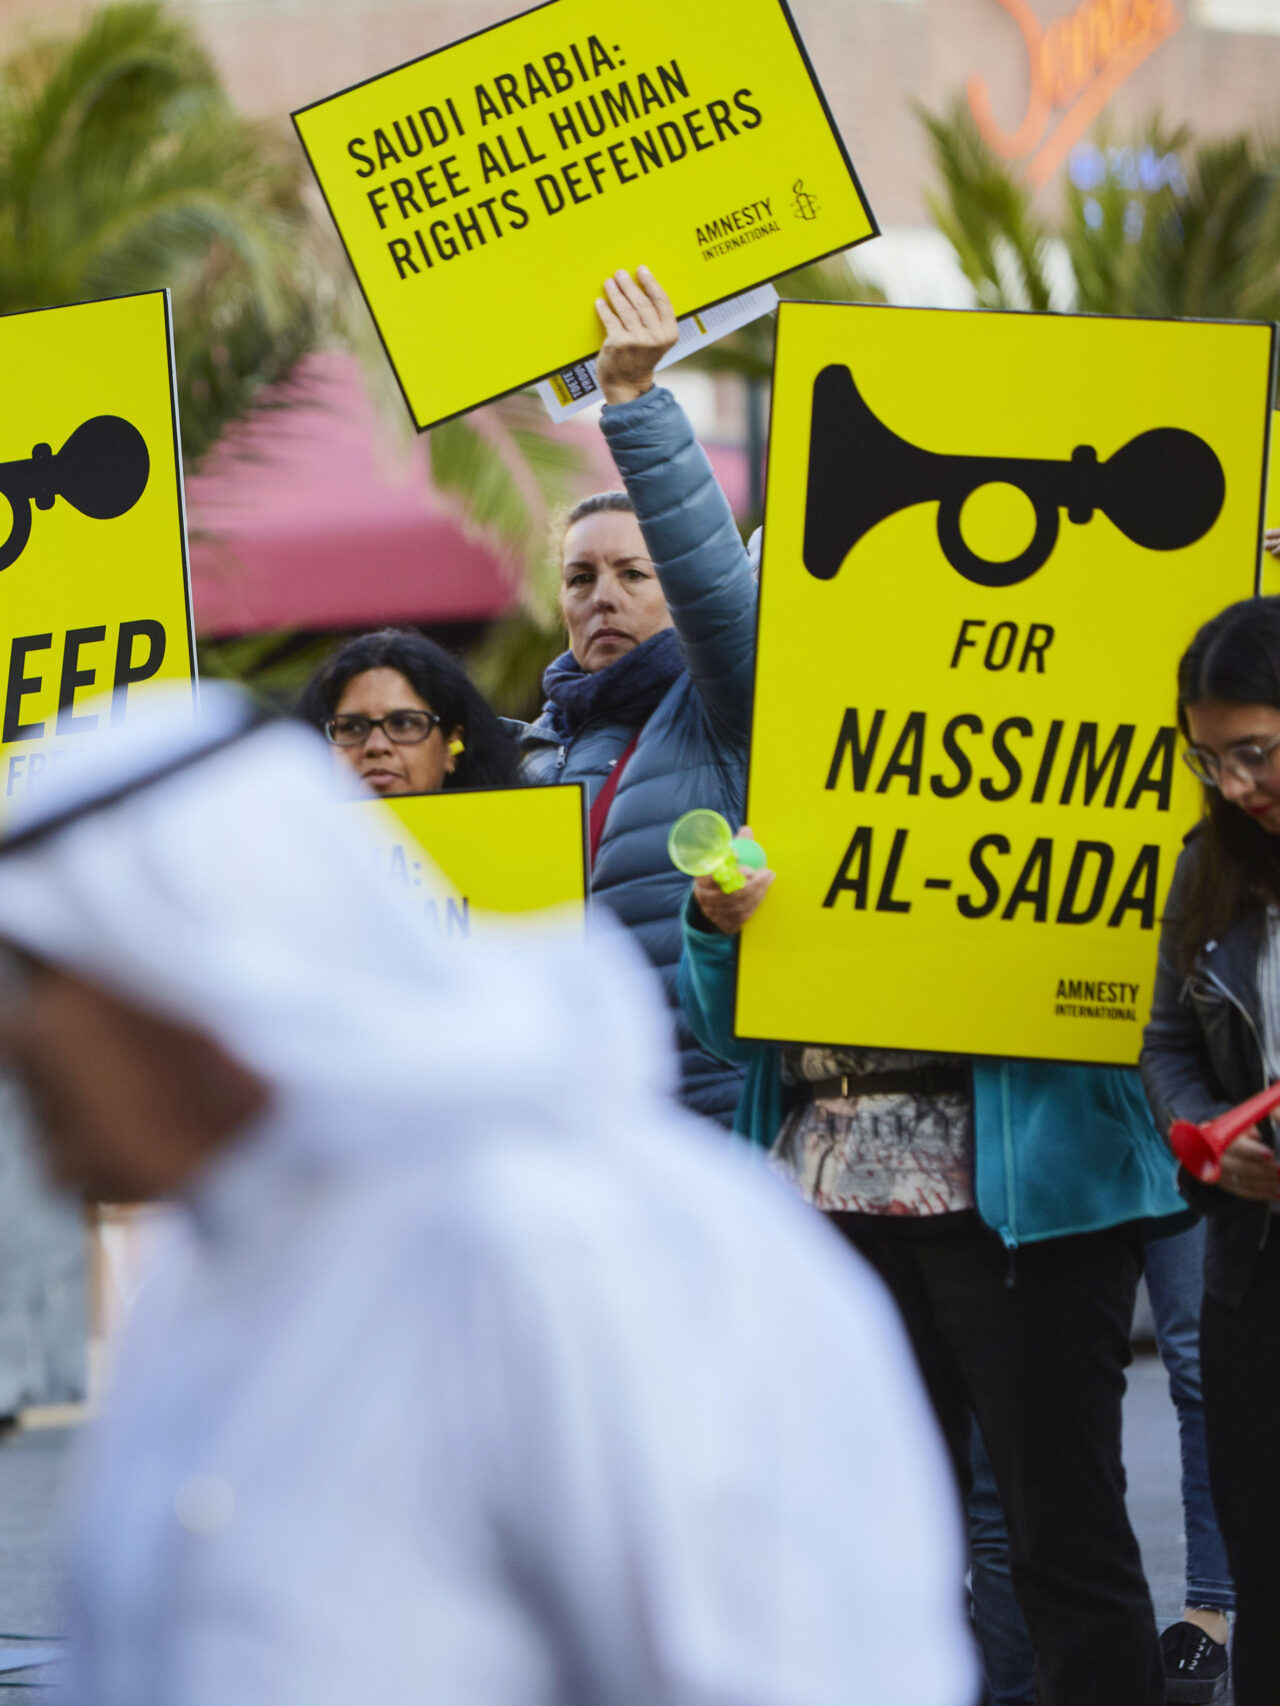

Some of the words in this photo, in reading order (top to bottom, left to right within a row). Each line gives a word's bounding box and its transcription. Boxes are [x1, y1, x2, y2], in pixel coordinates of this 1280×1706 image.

[347, 98, 464, 177] SAUDI
[475, 36, 626, 127] ARABIA:
[366, 155, 470, 229] FREE
[477, 126, 547, 184] ALL
[549, 60, 690, 150] HUMAN
[387, 189, 529, 280] RIGHTS
[535, 88, 762, 216] DEFENDERS
[695, 197, 772, 247] AMNESTY
[702, 220, 782, 262] INTERNATIONAL
[950, 619, 1055, 674] FOR
[824, 707, 1177, 812] NASSIMA
[822, 826, 1161, 931] AL-SADA
[1055, 978, 1140, 1004] AMNESTY
[1055, 1003, 1137, 1022] INTERNATIONAL
